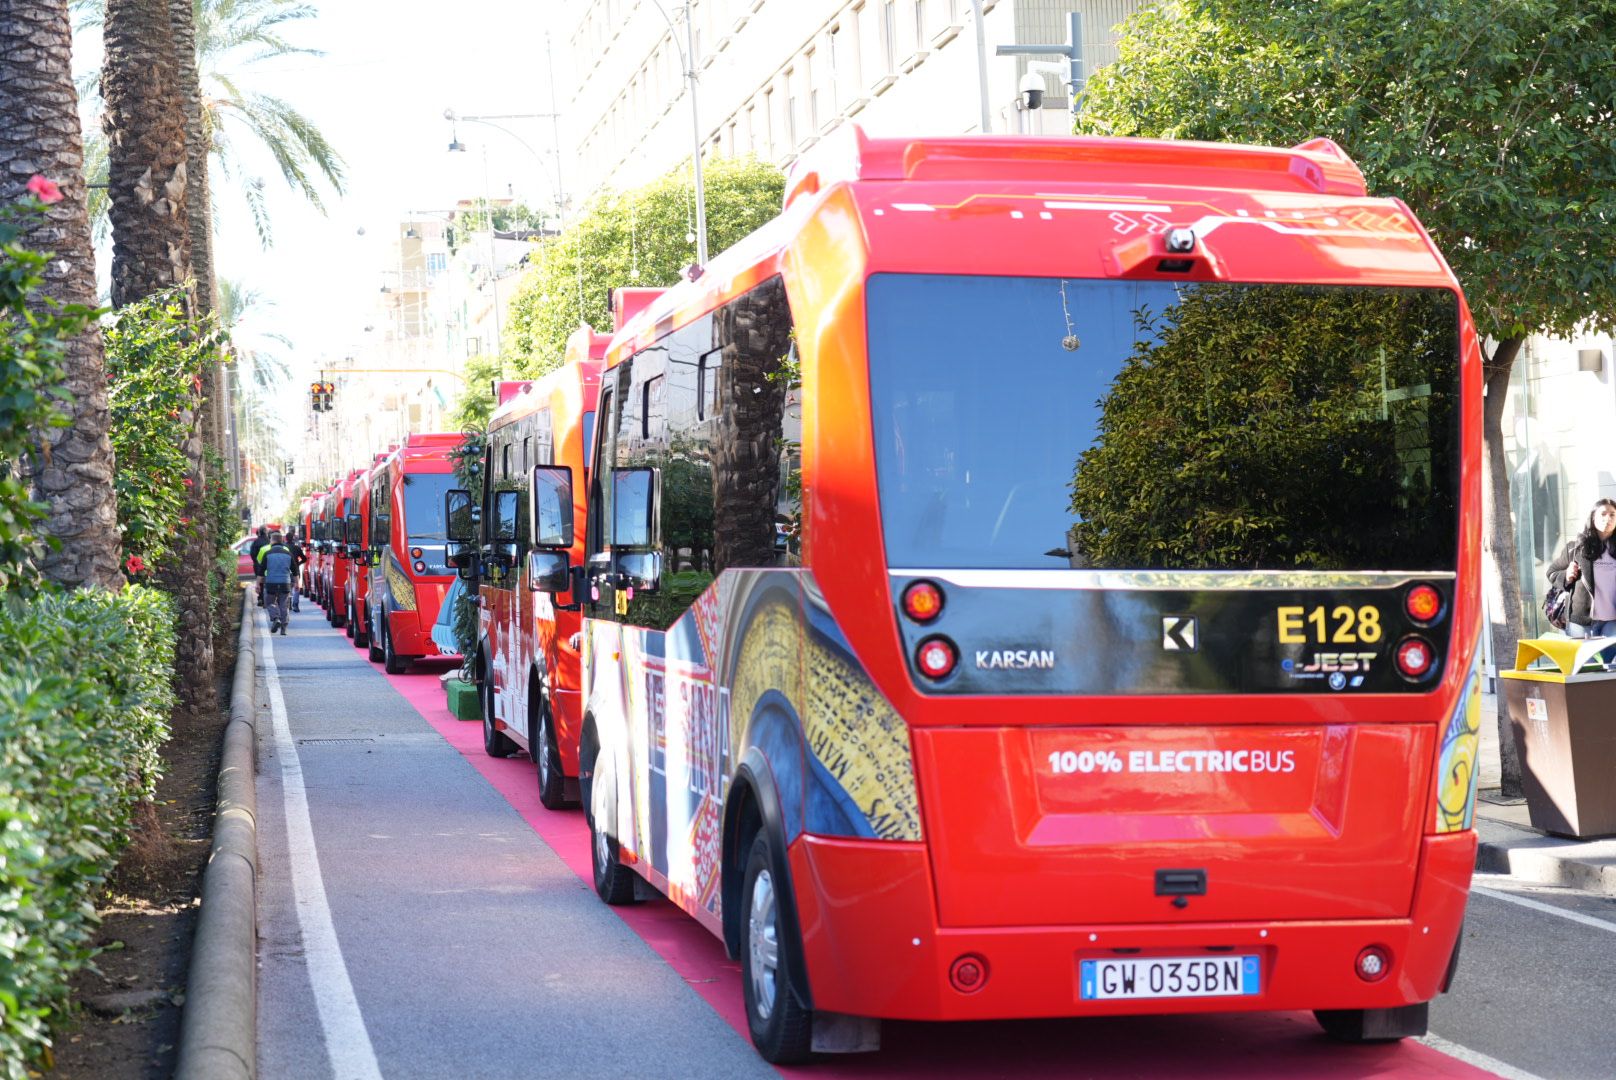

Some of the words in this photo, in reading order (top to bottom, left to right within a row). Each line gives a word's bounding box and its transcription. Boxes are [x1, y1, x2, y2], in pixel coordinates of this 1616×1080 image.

[1277, 605, 1382, 643] E128
[976, 650, 1055, 669] KARSAN
[1048, 751, 1122, 773] 100%
